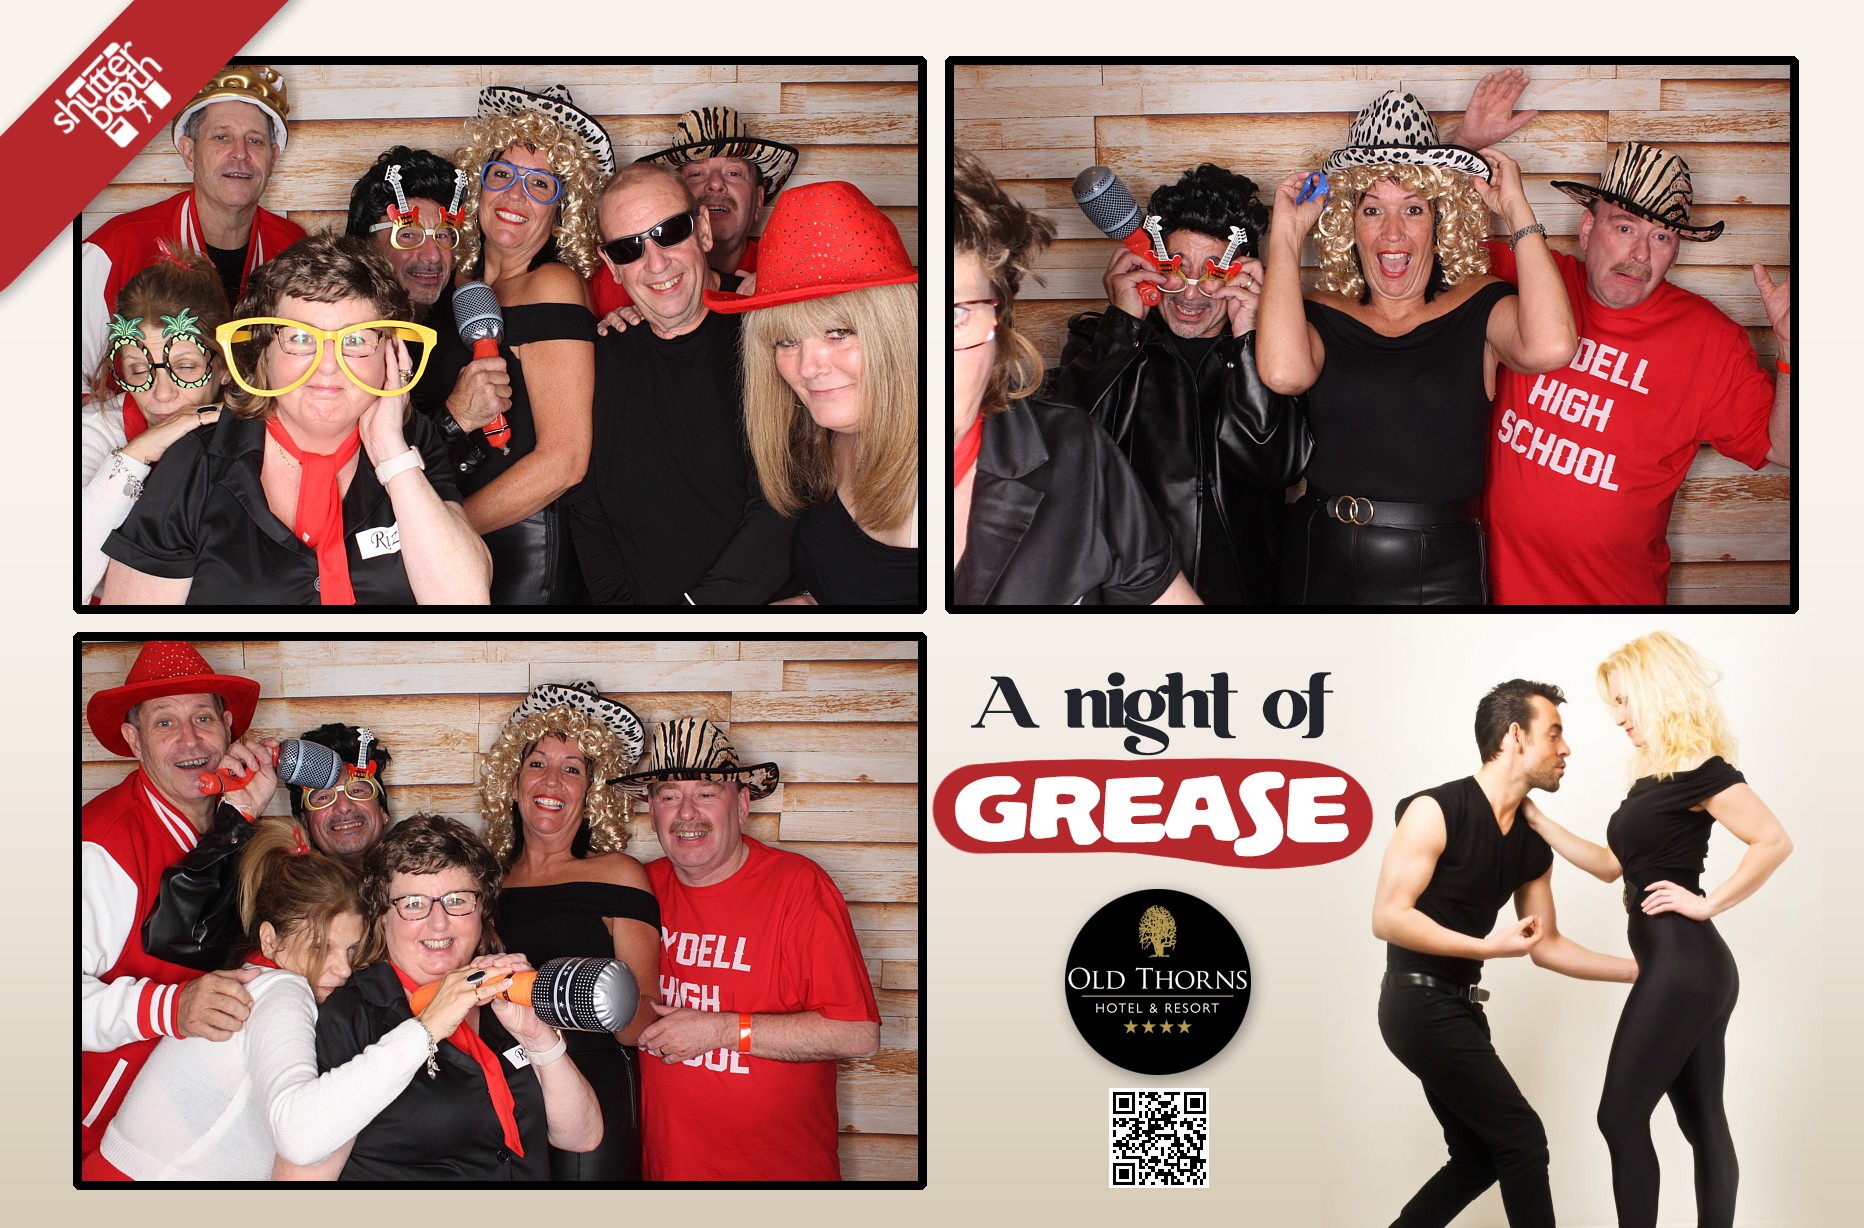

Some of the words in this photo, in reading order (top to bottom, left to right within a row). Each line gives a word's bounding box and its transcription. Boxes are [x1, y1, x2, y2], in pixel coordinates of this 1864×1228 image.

[1569, 336, 1650, 395] DELL
[1528, 373, 1614, 433] HIGH
[1498, 408, 1619, 492] SCHOOL
[661, 926, 752, 972] YDELL
[660, 974, 720, 1013] HIGH
